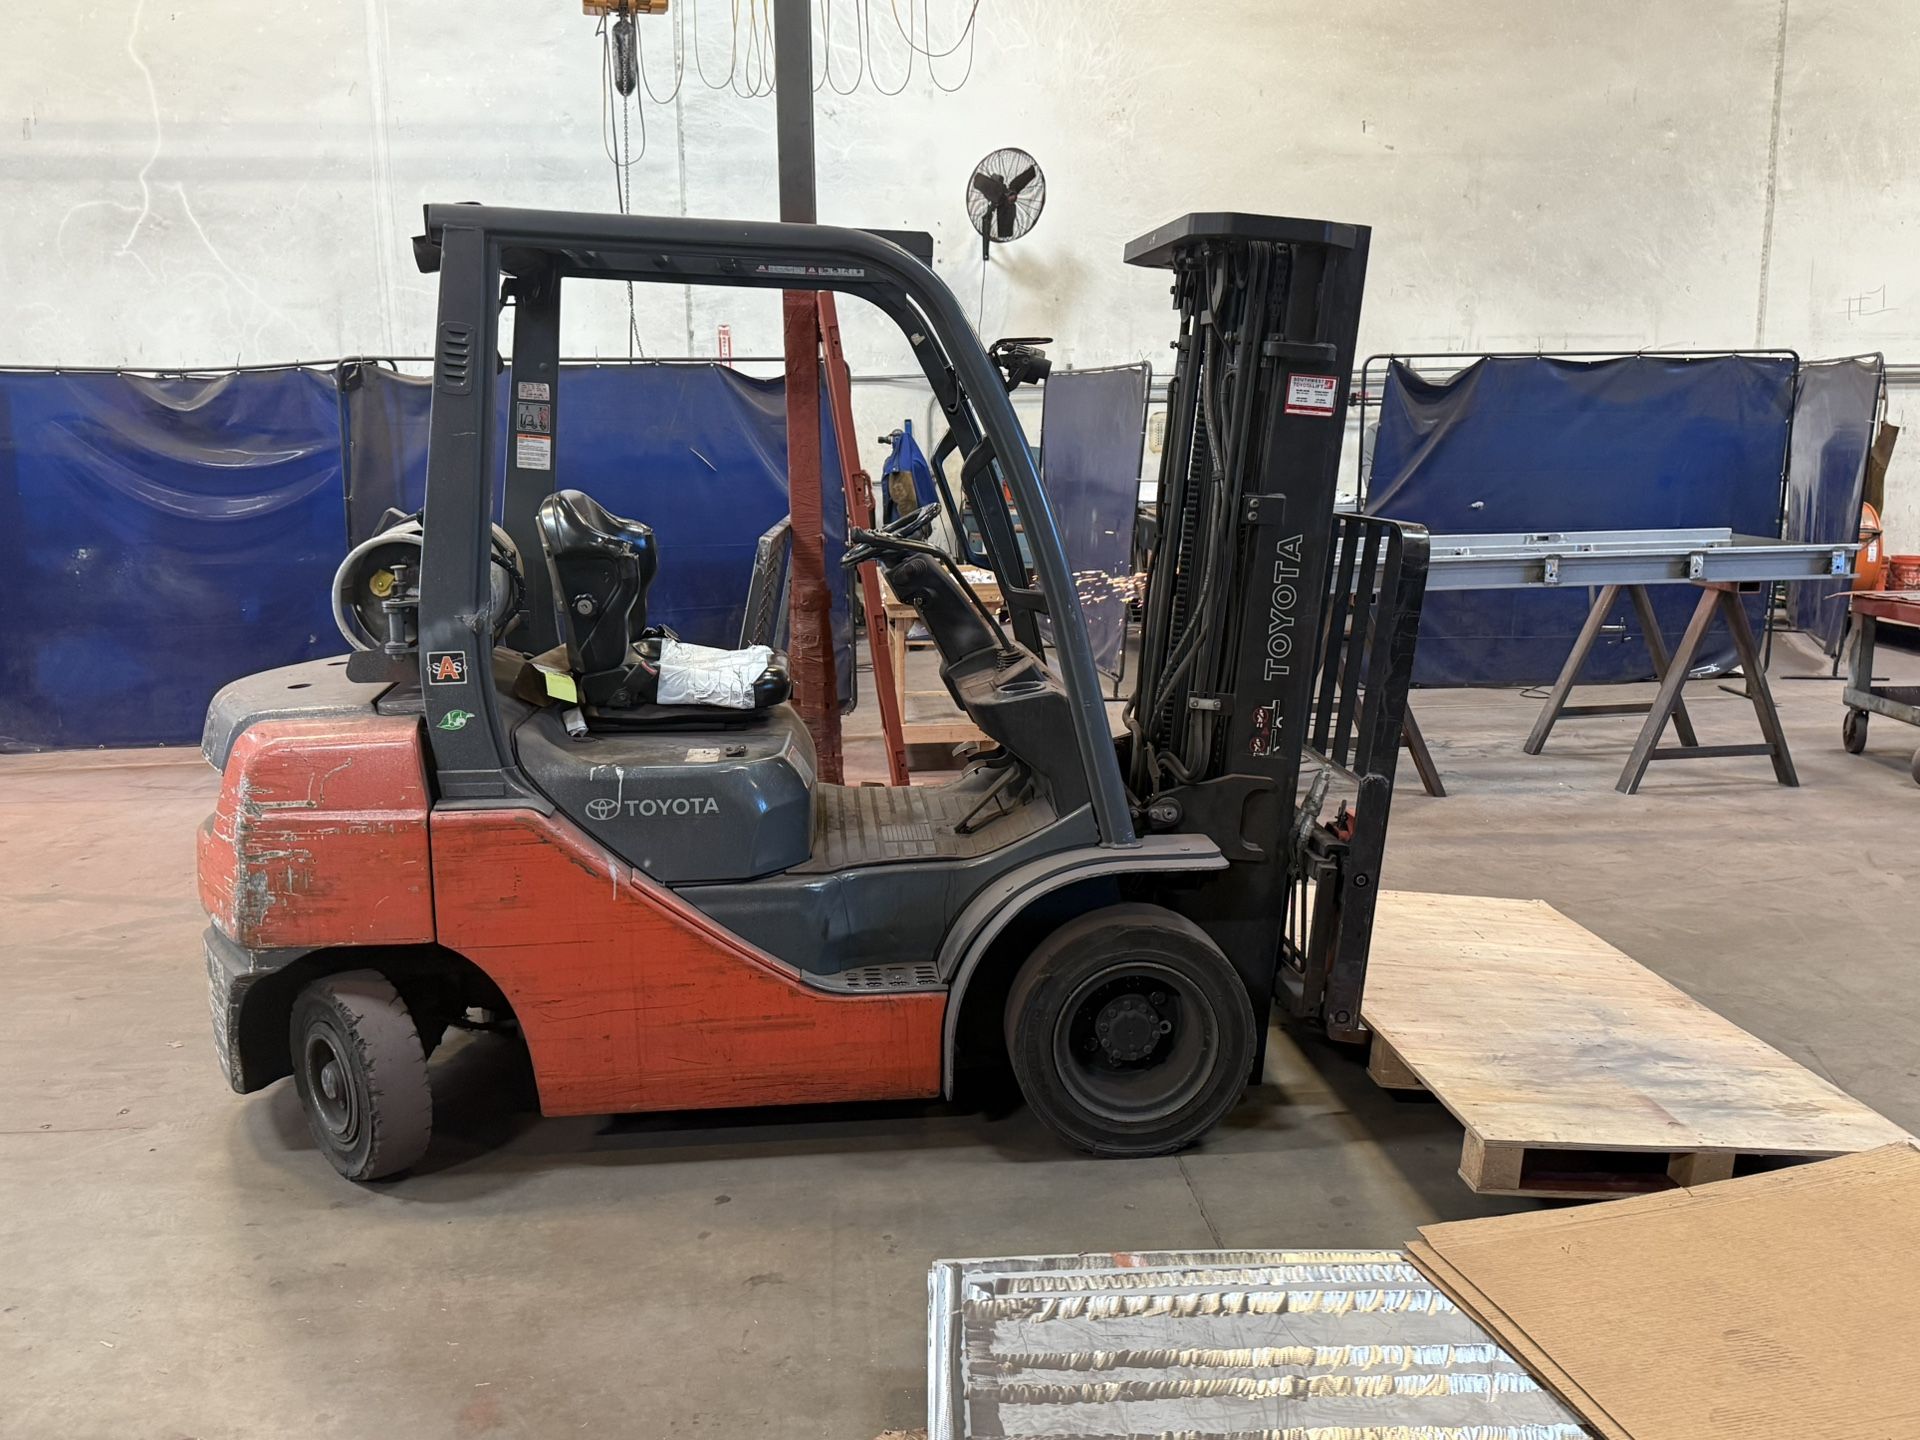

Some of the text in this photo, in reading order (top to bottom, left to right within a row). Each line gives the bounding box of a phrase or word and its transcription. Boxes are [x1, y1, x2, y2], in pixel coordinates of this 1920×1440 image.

[1264, 534, 1303, 681] TOYOTA
[432, 655, 463, 680] SAS
[624, 797, 720, 817] TOYOTA
